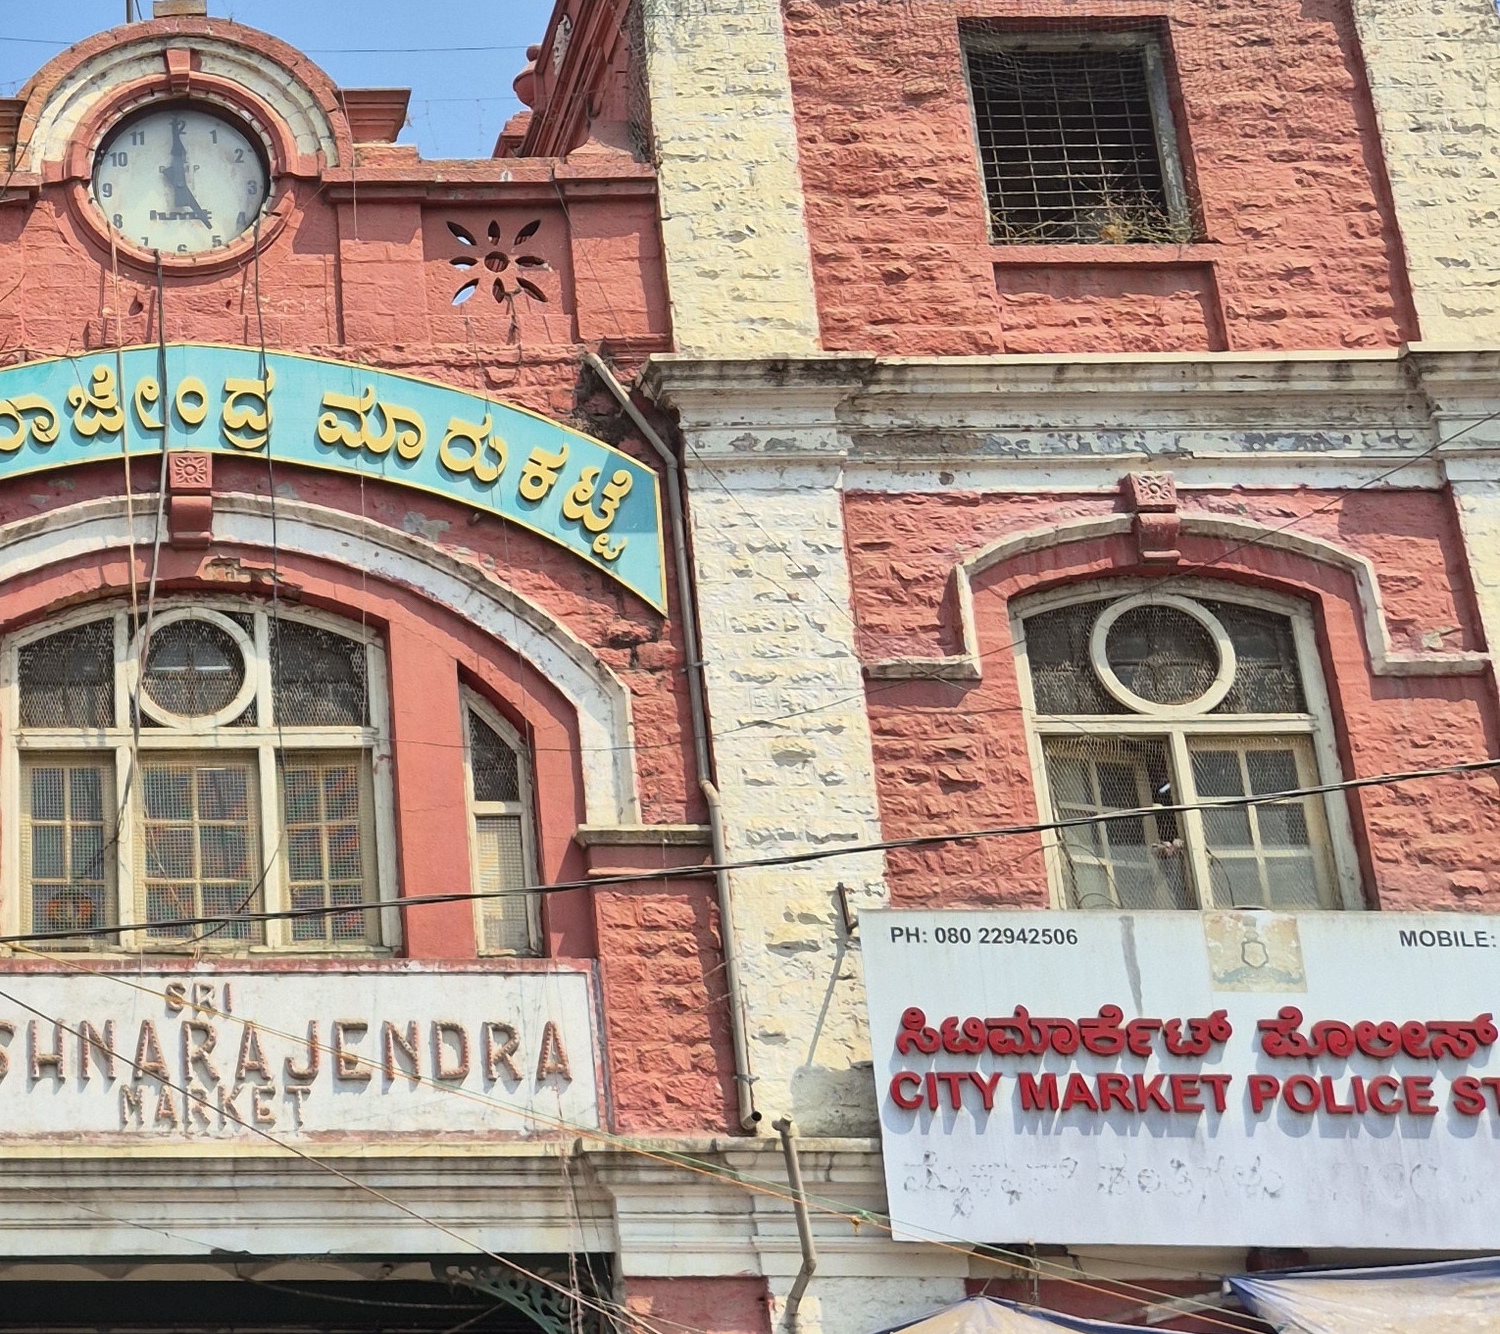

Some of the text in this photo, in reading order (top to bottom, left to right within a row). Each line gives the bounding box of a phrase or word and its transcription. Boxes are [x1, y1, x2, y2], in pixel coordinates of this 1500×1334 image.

[130, 131, 145, 146] 11
[209, 129, 218, 144] 1
[110, 151, 128, 167] 10
[234, 148, 245, 164] 2
[102, 183, 113, 198] 9
[247, 180, 258, 195] 3
[113, 214, 124, 229] 8
[212, 235, 223, 248] 5
[318, 384, 634, 562] ಮಾರುಕಟ್ಟೆ
[890, 926, 1079, 946] PH: 080 22942506
[1398, 929, 1497, 948] MOBILE:
[165, 982, 233, 1012] SRI
[1256, 1005, 1499, 1060] ಪೊಲೀಸ್
[890, 1070, 1003, 1112] CITY
[1017, 1071, 1233, 1114] MARKET
[1247, 1073, 1440, 1115] POLICE
[121, 1082, 311, 1128] MARKET
